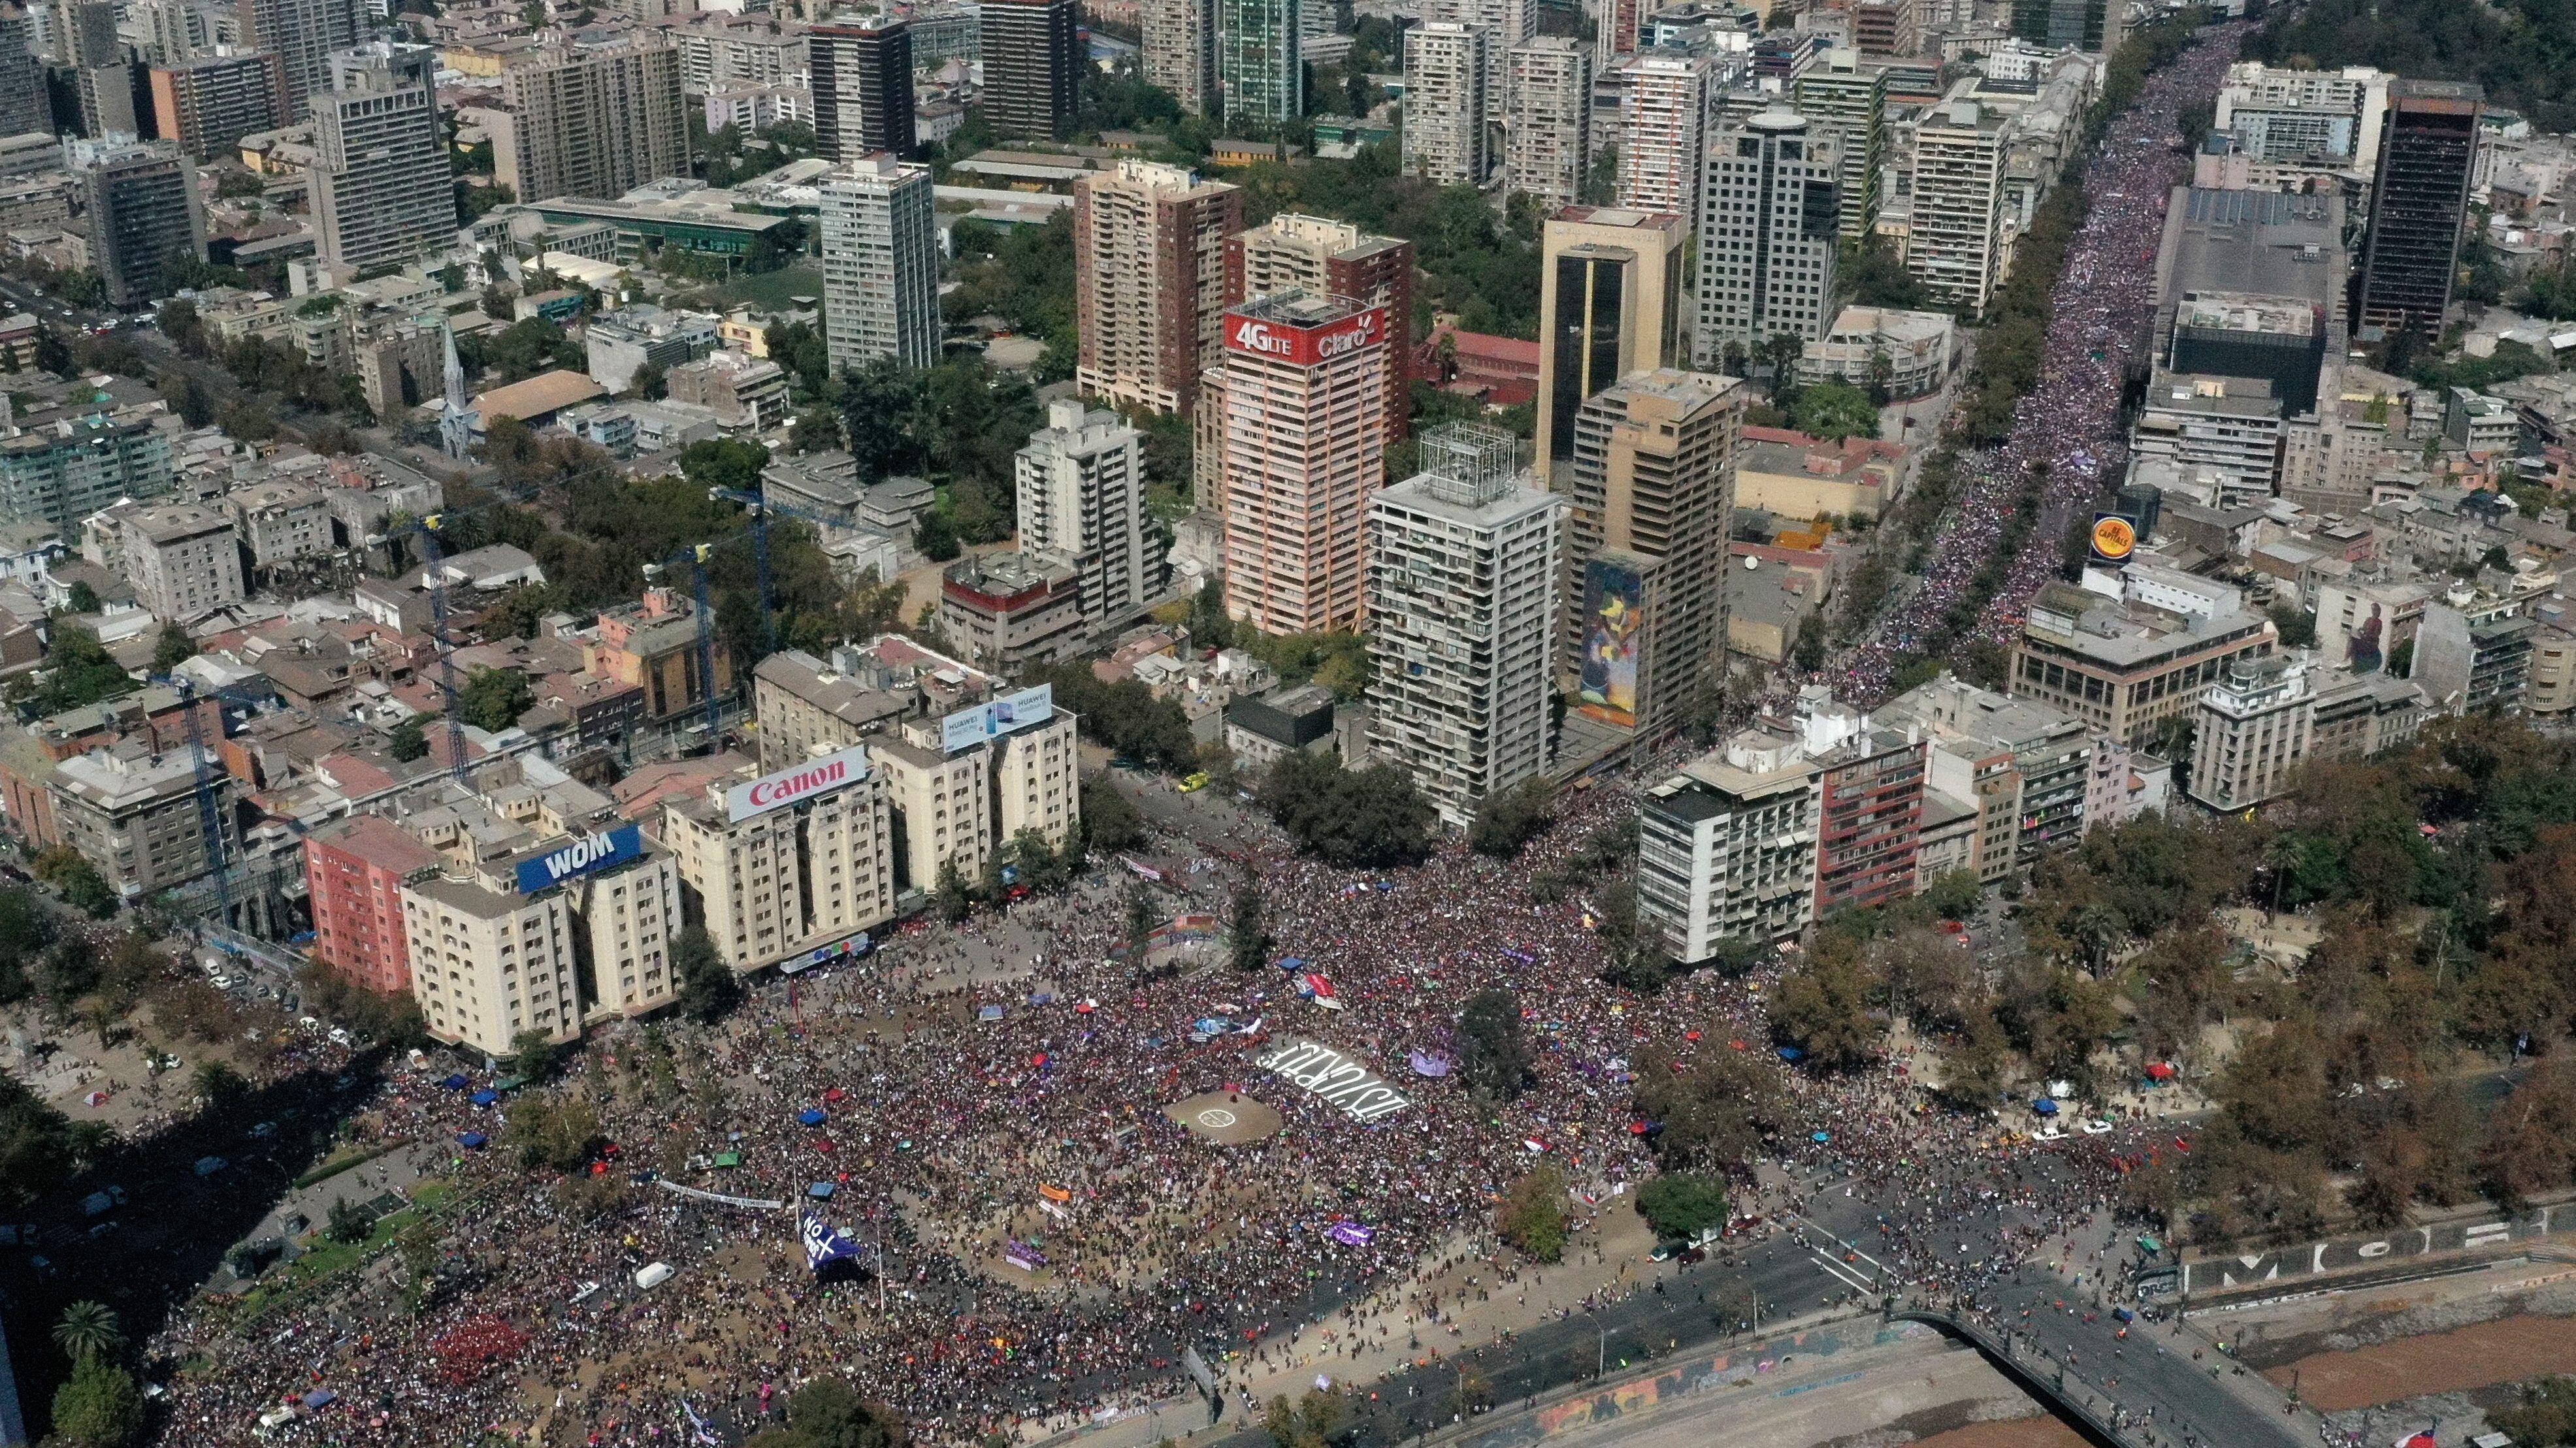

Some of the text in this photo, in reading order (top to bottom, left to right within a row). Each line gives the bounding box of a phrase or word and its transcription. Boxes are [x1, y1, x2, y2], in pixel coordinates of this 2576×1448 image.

[1236, 321, 1269, 351] 4G
[1318, 328, 1366, 357] Claro
[1019, 692, 1047, 707] HUAWEI
[949, 716, 977, 730] HUAWEI
[749, 760, 846, 806] Canon
[545, 831, 615, 878] WOM
[804, 1215, 823, 1237] NO
